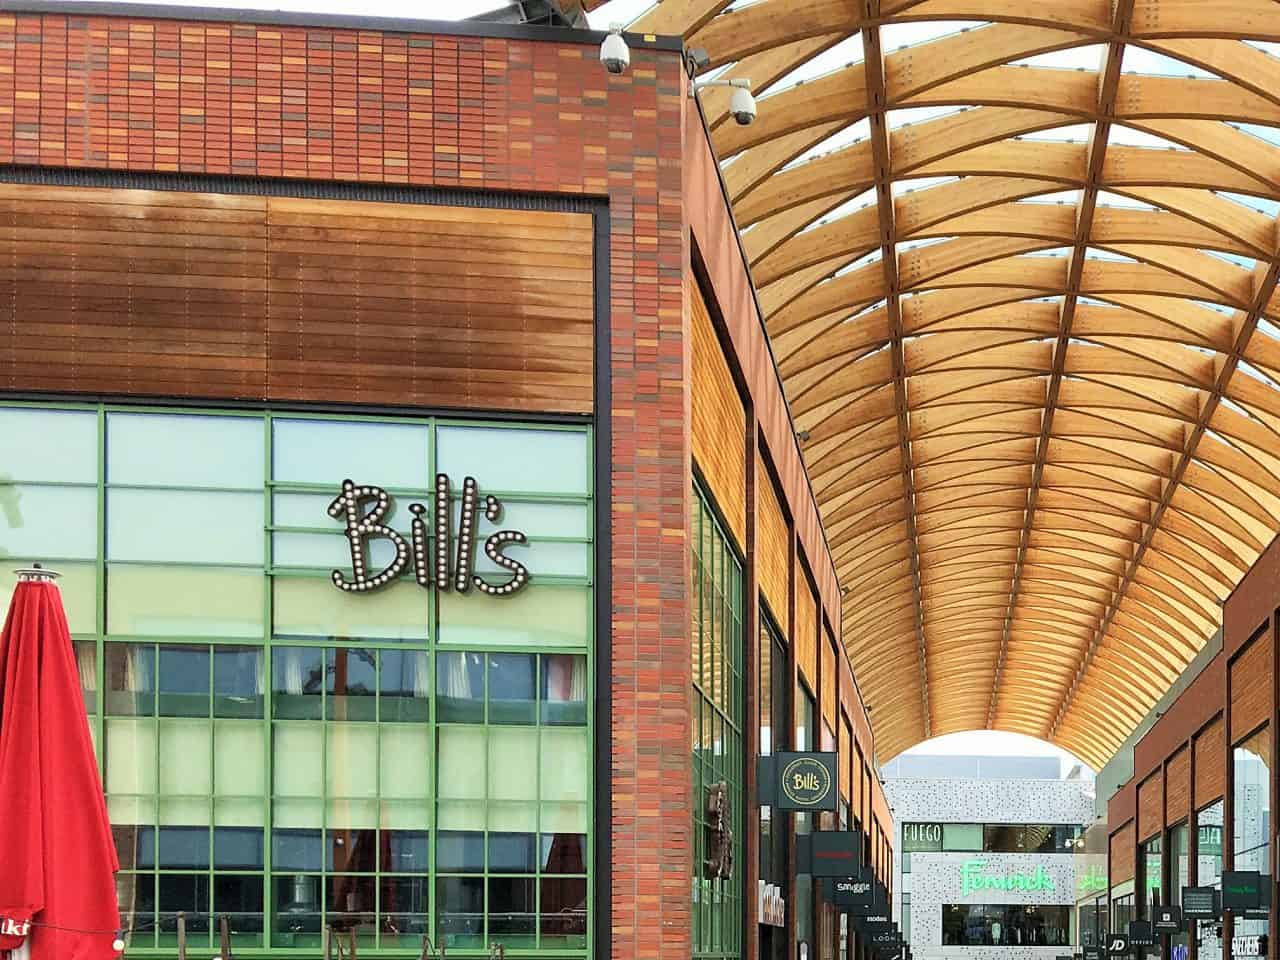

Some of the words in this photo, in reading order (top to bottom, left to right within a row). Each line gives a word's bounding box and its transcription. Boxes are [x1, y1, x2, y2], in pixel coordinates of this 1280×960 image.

[327, 473, 528, 596] Bill's
[793, 773, 820, 790] Bill's
[904, 824, 941, 842] FUEGO
[960, 859, 1056, 896] Fenwick
[1109, 939, 1125, 951] JD
